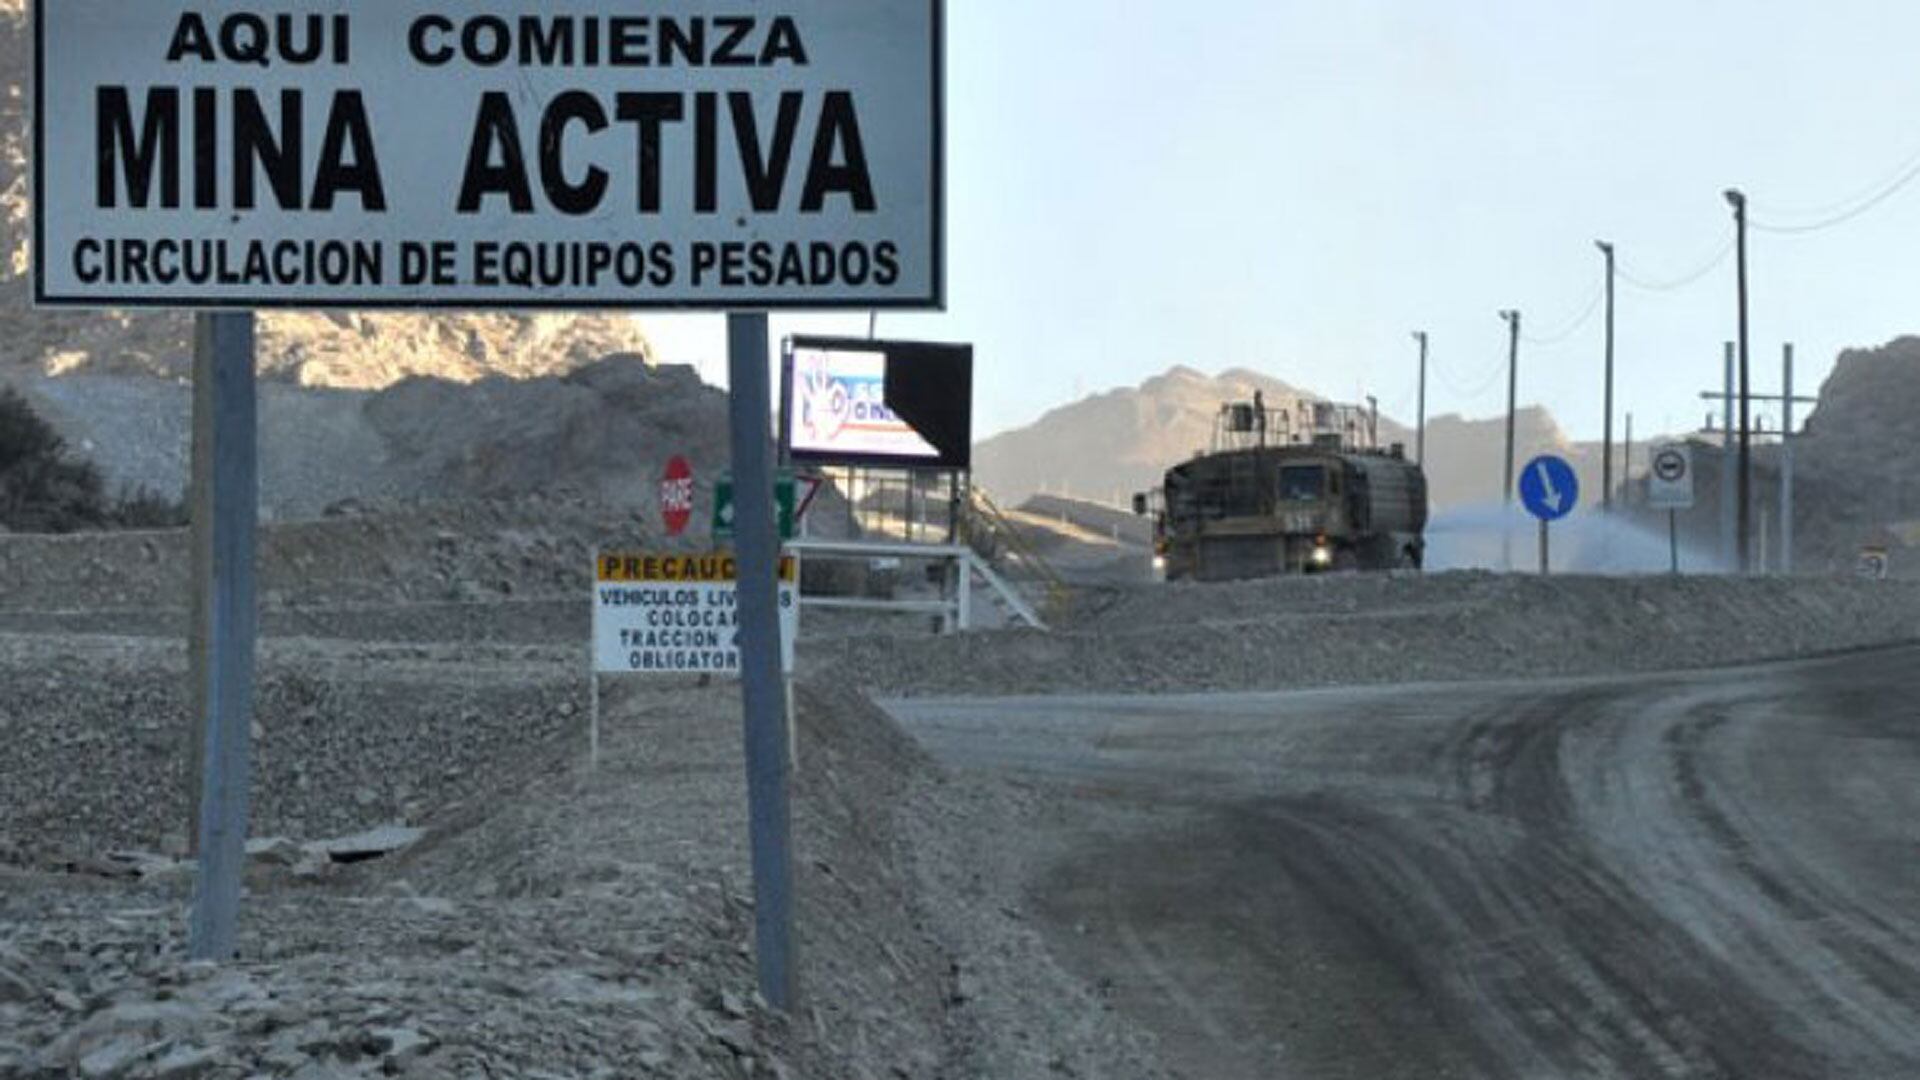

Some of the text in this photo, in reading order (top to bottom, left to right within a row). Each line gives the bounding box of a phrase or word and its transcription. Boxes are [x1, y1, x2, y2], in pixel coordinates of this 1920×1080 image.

[166, 12, 809, 67] AQUI COMIENZA
[96, 85, 876, 214] MINA ACTIVA
[73, 238, 899, 288] CIRCULACION DE EQUIPOS PESADOS
[605, 556, 787, 581] PRECAUC
[600, 589, 699, 606] VEHICULOS
[620, 629, 718, 647] TRACCION
[630, 651, 737, 669] OBLIGATOR
